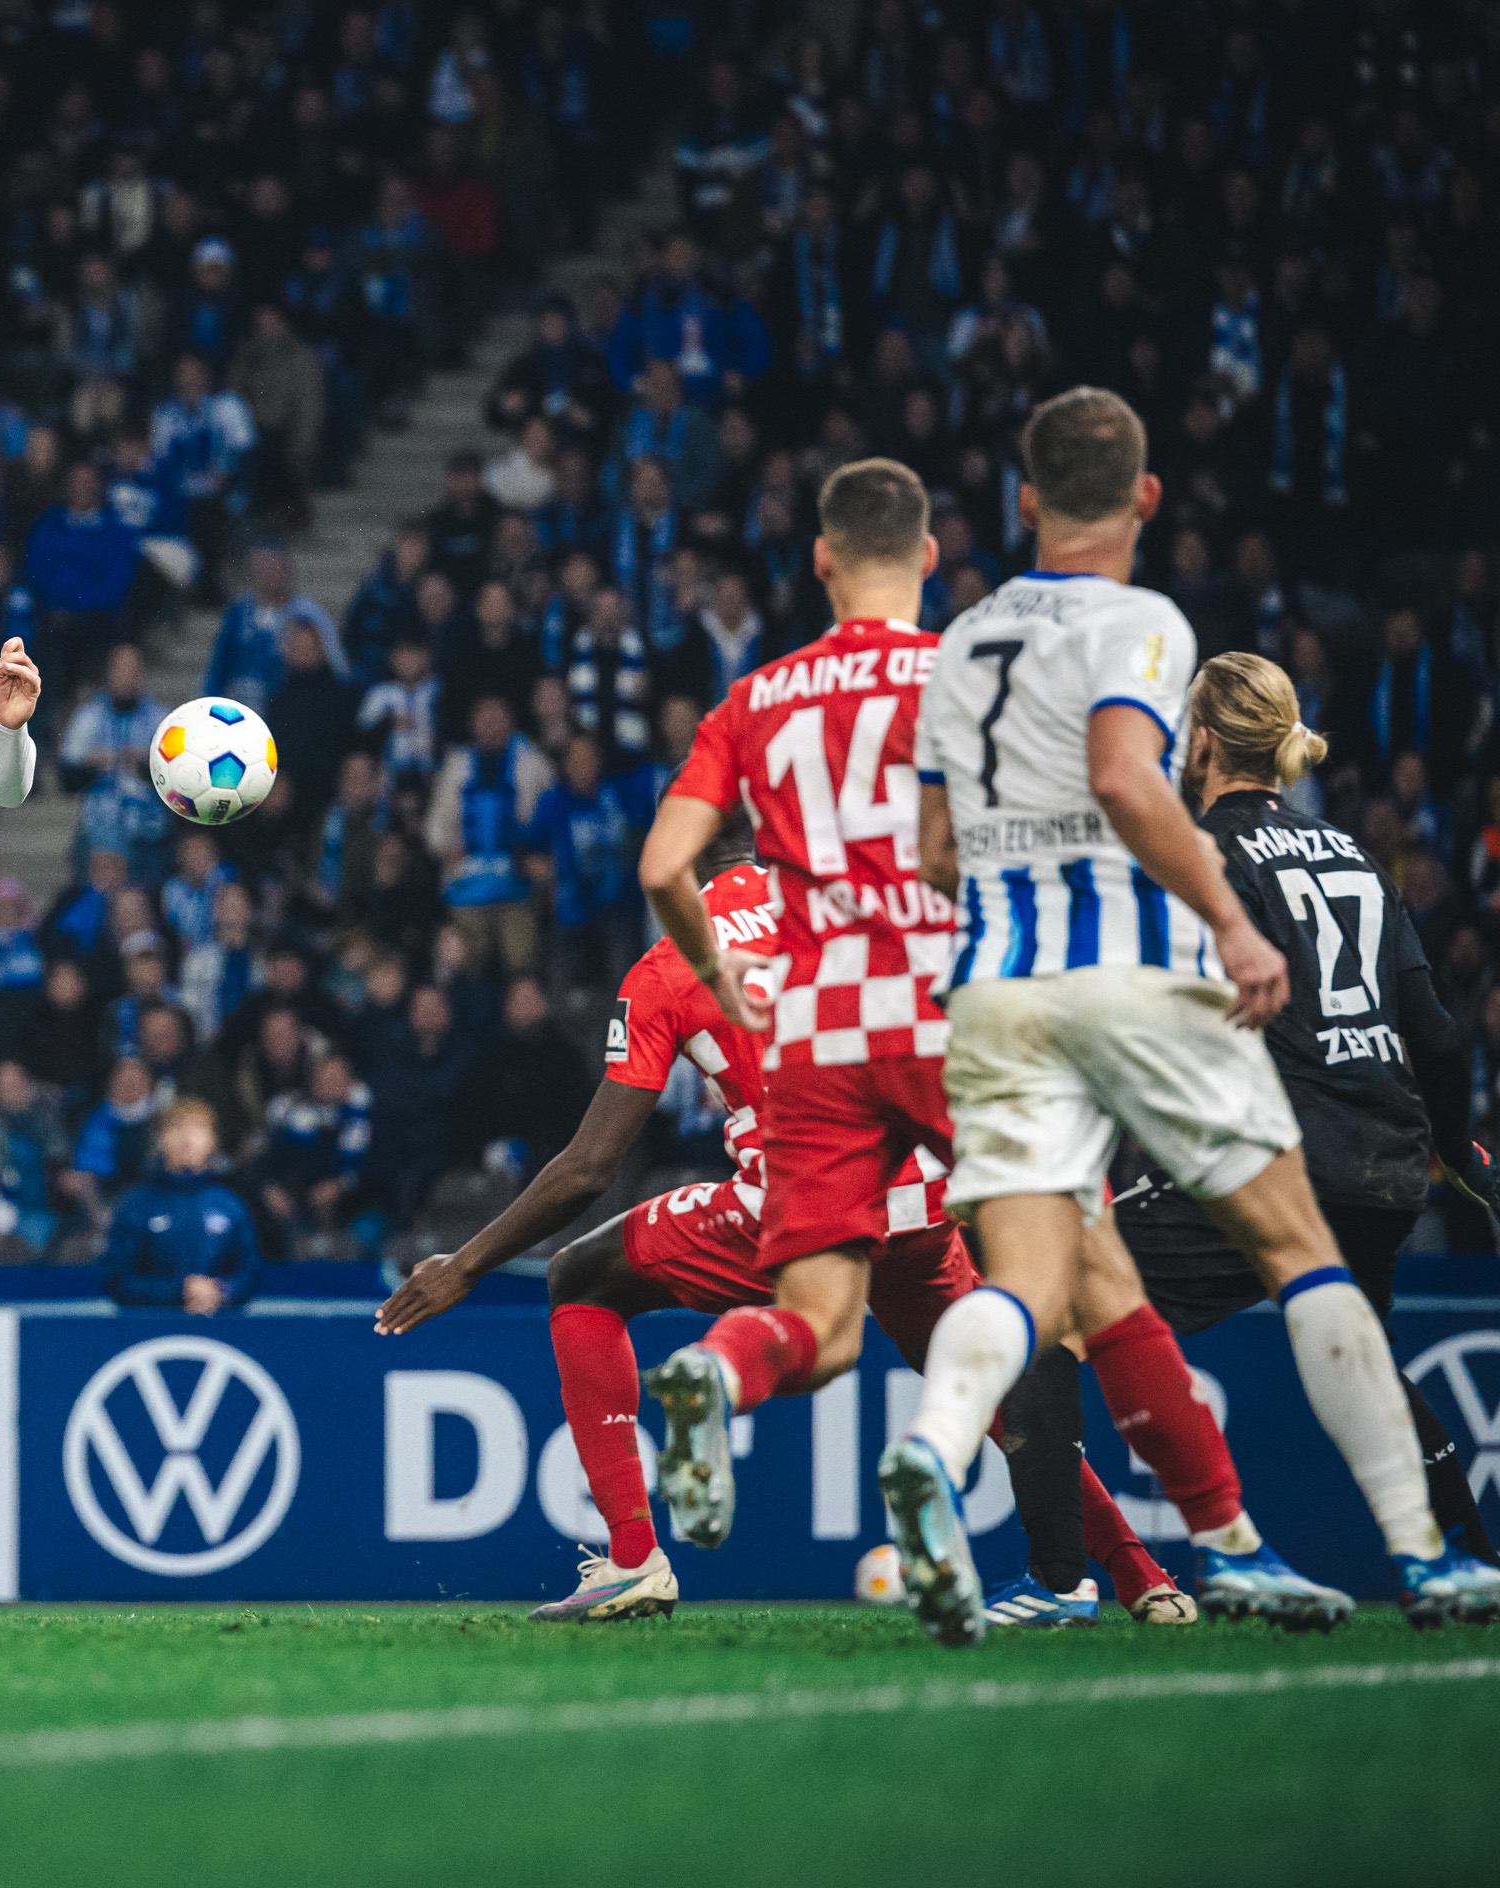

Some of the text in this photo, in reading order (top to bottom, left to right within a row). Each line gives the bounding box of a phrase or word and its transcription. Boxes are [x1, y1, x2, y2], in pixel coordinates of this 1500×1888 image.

[749, 648, 882, 712] MAINZ
[970, 640, 1024, 806] 7
[766, 695, 919, 875] 14
[1275, 868, 1385, 1017] 27
